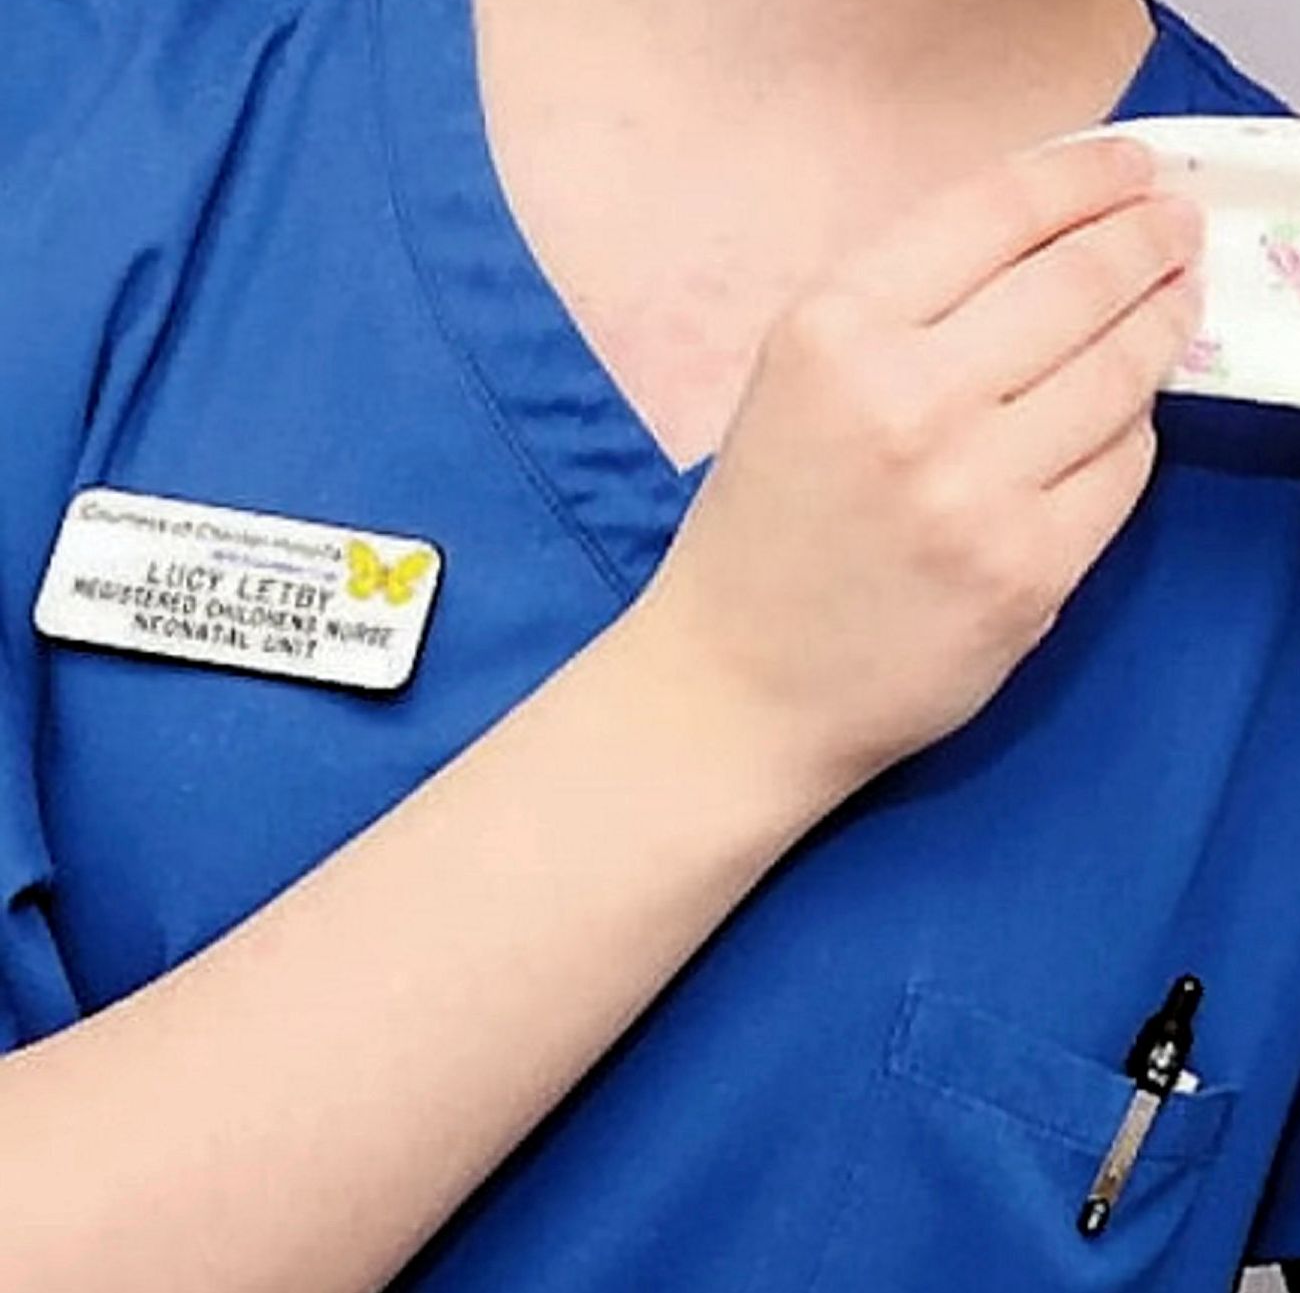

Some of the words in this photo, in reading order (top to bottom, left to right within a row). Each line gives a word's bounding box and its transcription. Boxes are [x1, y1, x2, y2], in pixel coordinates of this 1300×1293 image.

[146, 561, 223, 592] LUCY
[237, 575, 334, 611] LETBY
[73, 577, 194, 614] REGISTERED
[324, 620, 396, 649] NURSE
[132, 613, 251, 651] NEONATAL
[260, 634, 319, 659] UNIT
